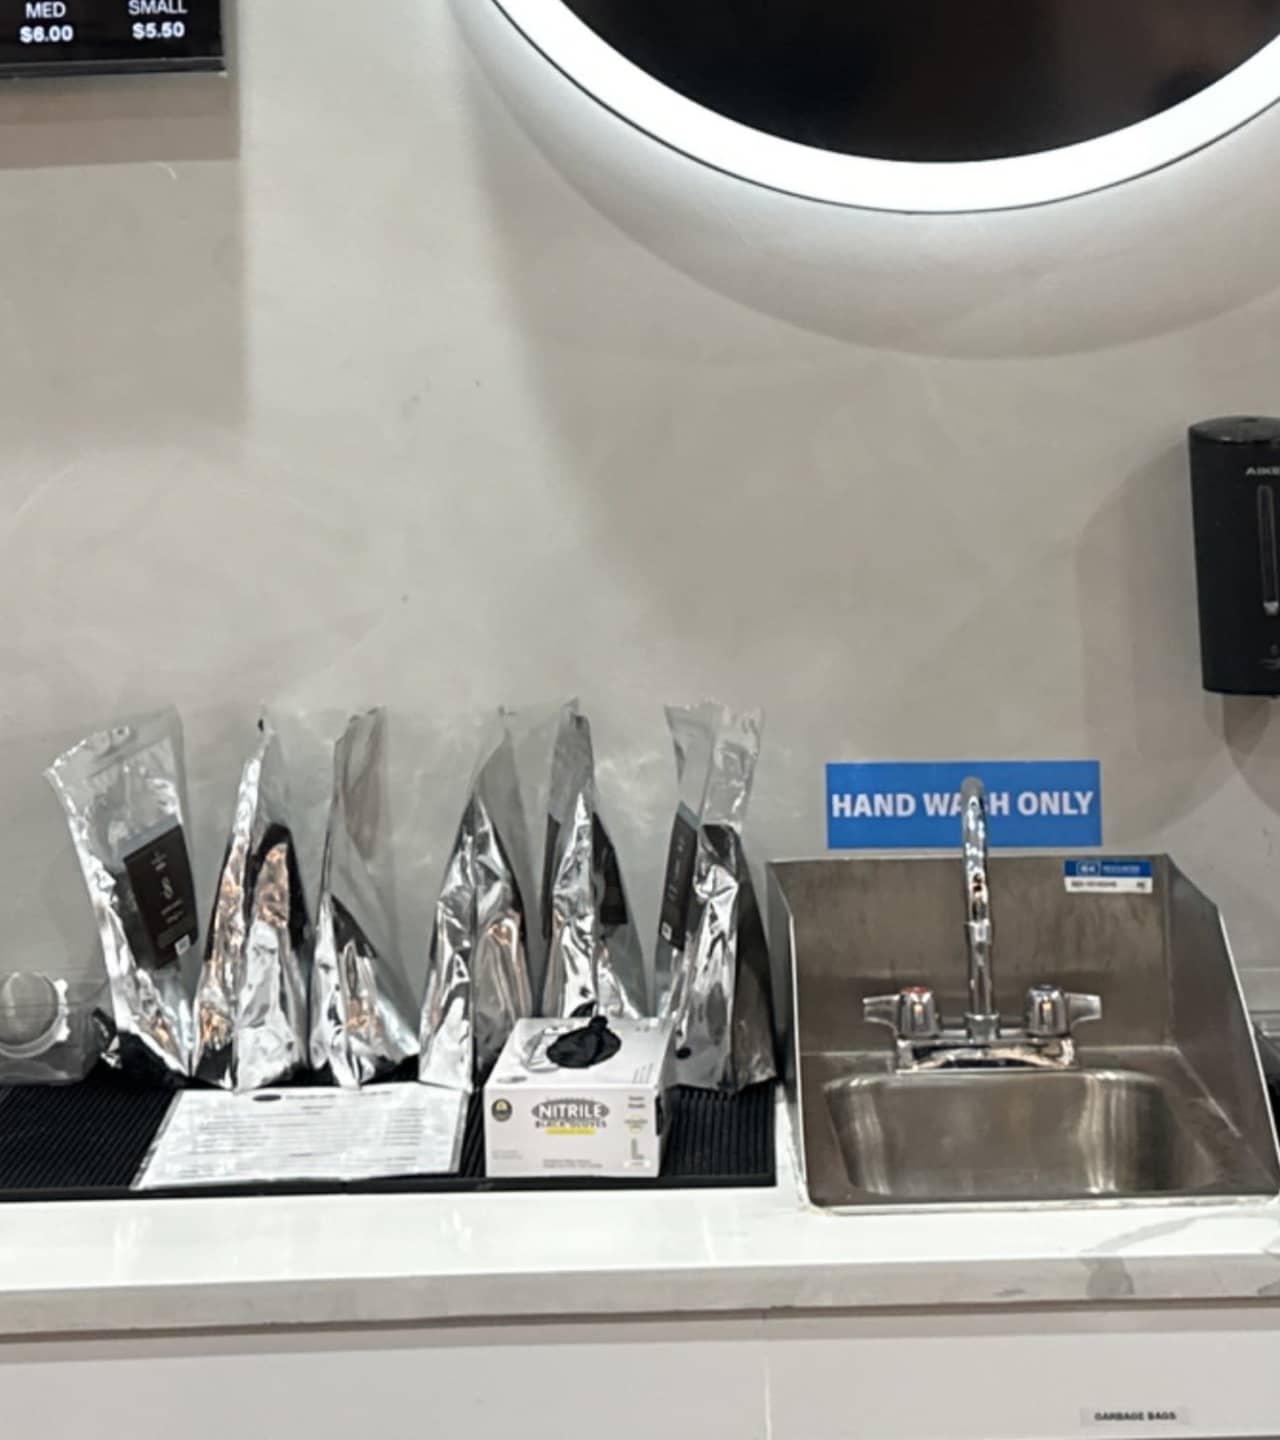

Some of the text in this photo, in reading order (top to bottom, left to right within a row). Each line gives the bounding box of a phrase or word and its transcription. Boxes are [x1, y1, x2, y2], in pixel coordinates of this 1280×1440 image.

[26, 1, 66, 19] MED
[20, 25, 73, 43] $6.00
[132, 21, 185, 40] $5.50
[832, 791, 1094, 818] HAND WAH ONLY
[538, 1101, 603, 1120] NITRILE
[1148, 1411, 1176, 1420] BAGS
